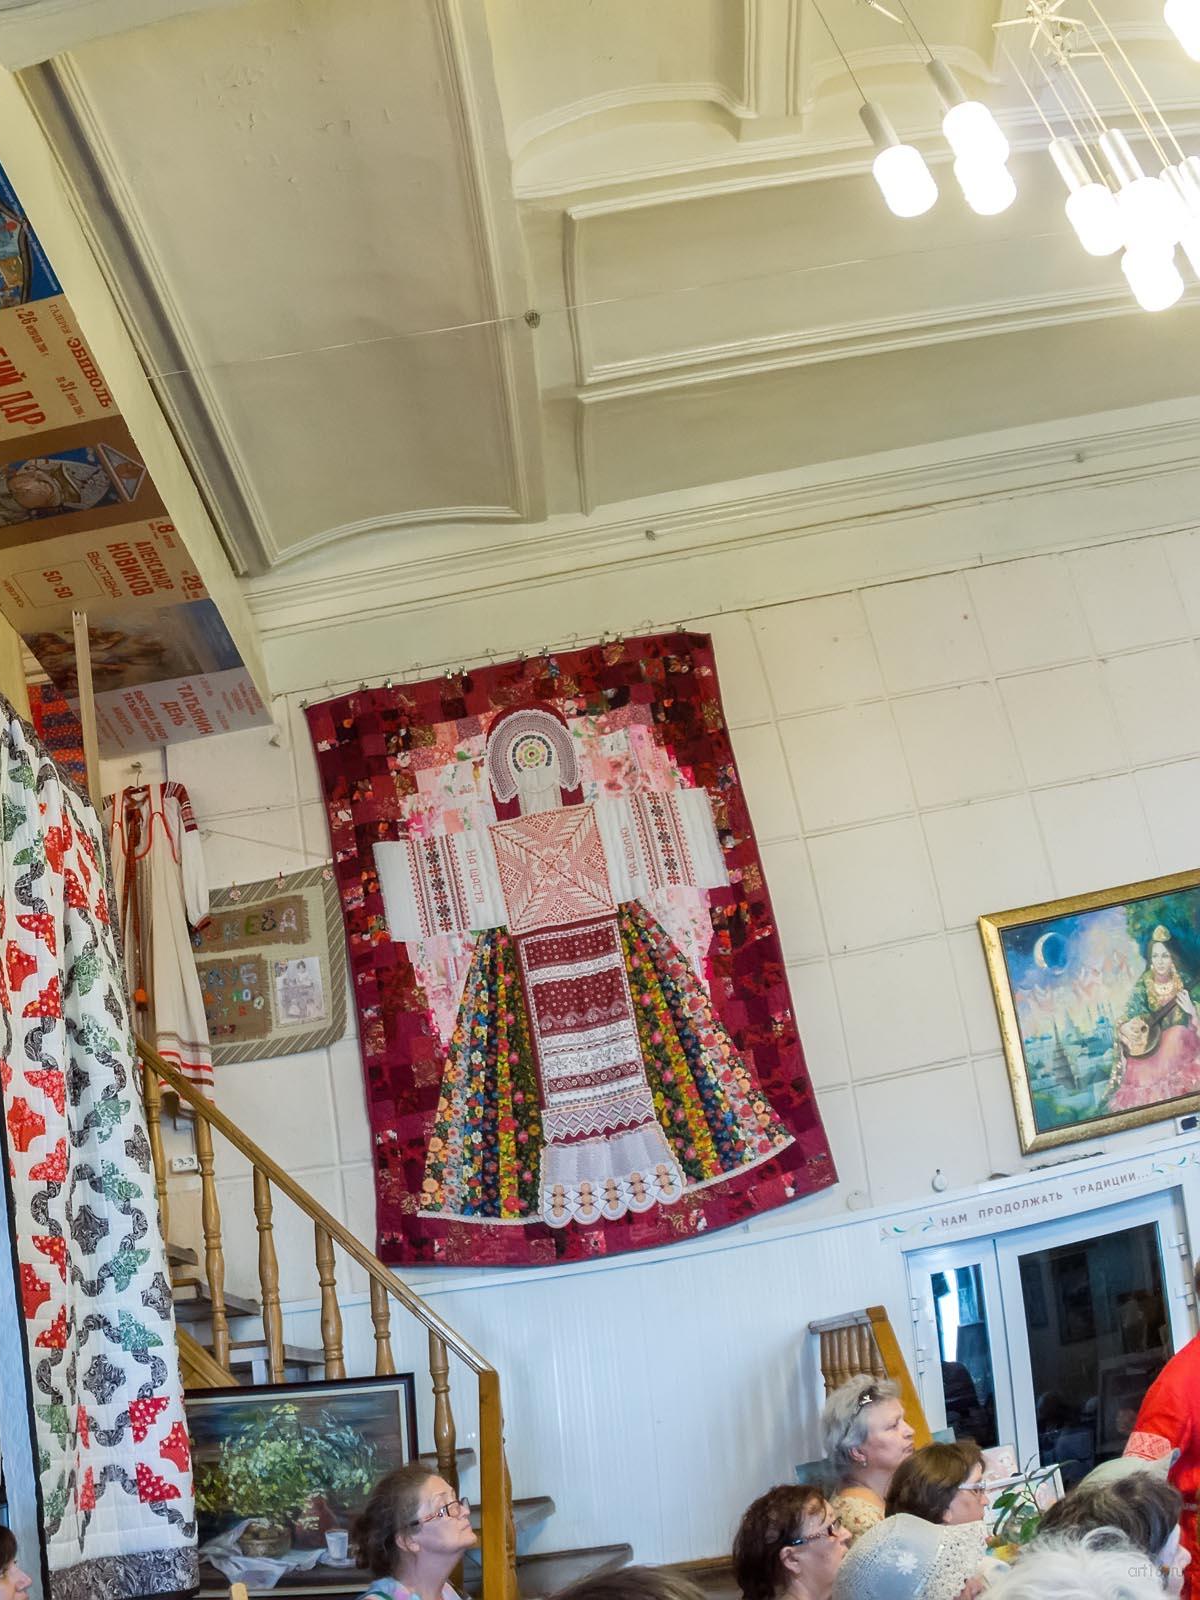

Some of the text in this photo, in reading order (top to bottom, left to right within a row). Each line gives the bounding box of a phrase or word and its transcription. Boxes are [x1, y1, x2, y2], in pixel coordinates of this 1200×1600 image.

[17, 311, 38, 325] 26
[59, 381, 78, 393] 31
[106, 541, 155, 597] НОВИКОВ
[134, 541, 175, 591] АЛЕКСАНДР
[157, 523, 176, 533] 8
[183, 574, 203, 591] 28
[940, 1213, 968, 1228] НАМ
[978, 1191, 1064, 1219] ПРОДОЛЖАТЬ
